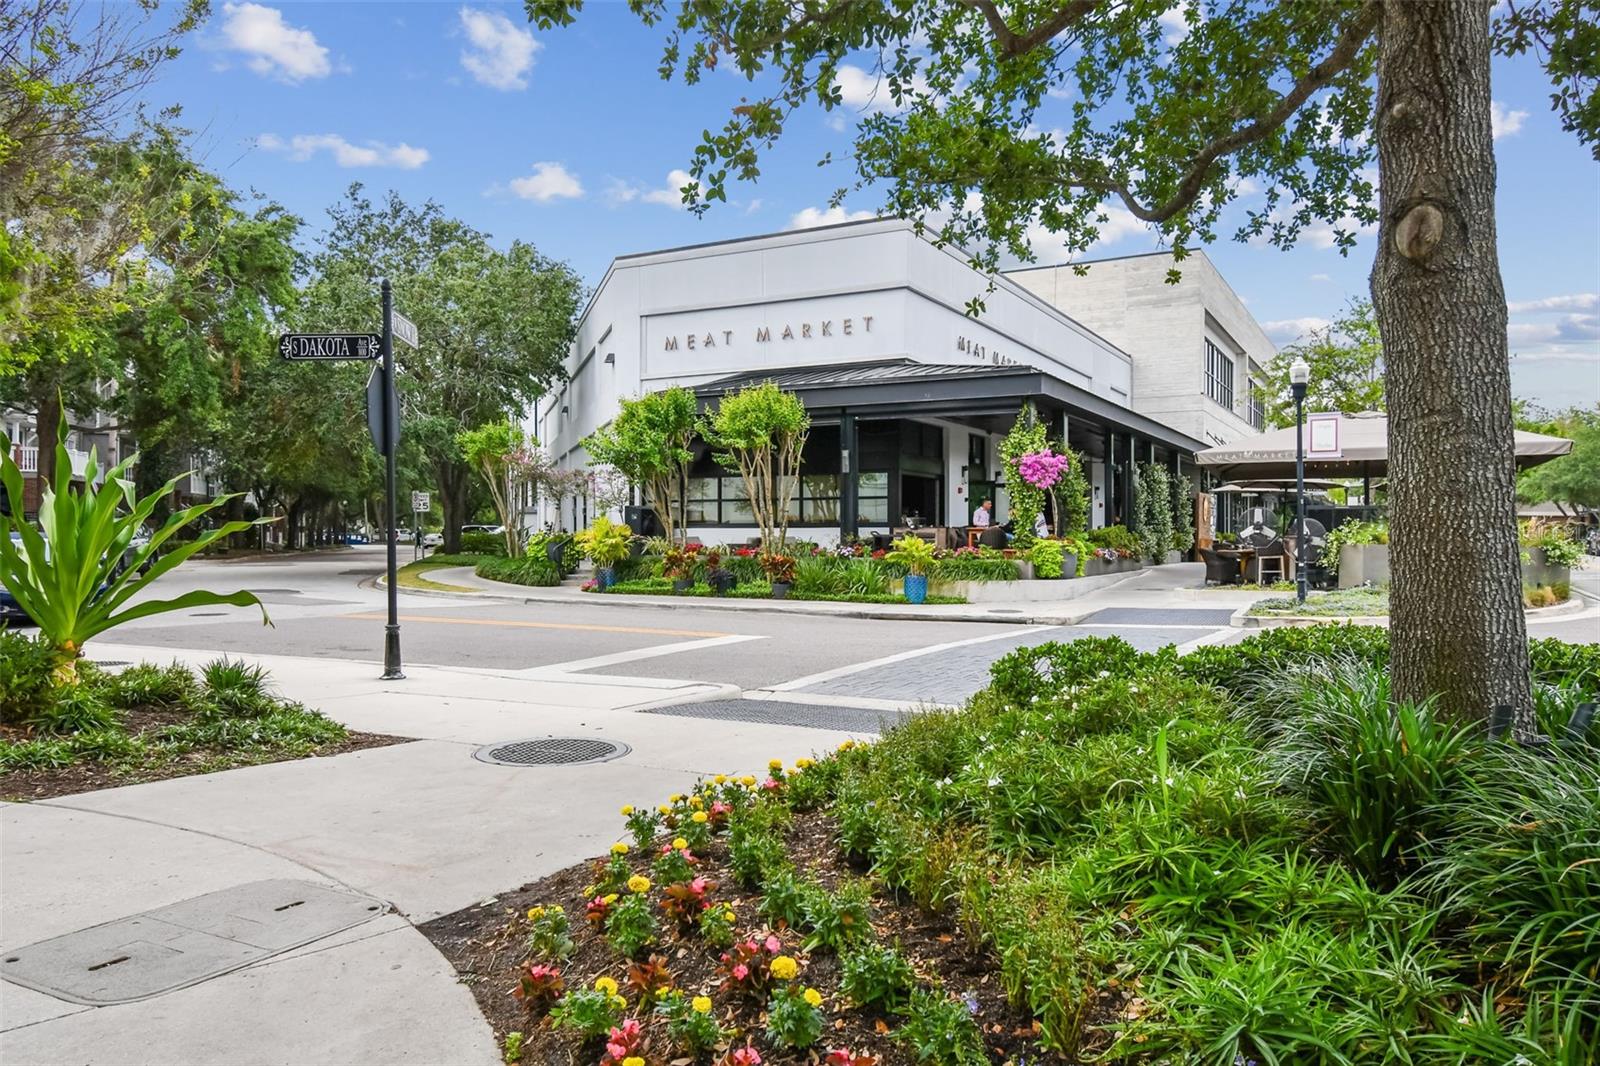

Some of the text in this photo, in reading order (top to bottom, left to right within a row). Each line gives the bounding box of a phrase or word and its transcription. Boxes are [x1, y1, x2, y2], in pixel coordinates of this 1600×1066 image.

[664, 316, 873, 351] MEAT MARKET
[293, 340, 298, 354] S
[300, 338, 350, 356] DAKOTA
